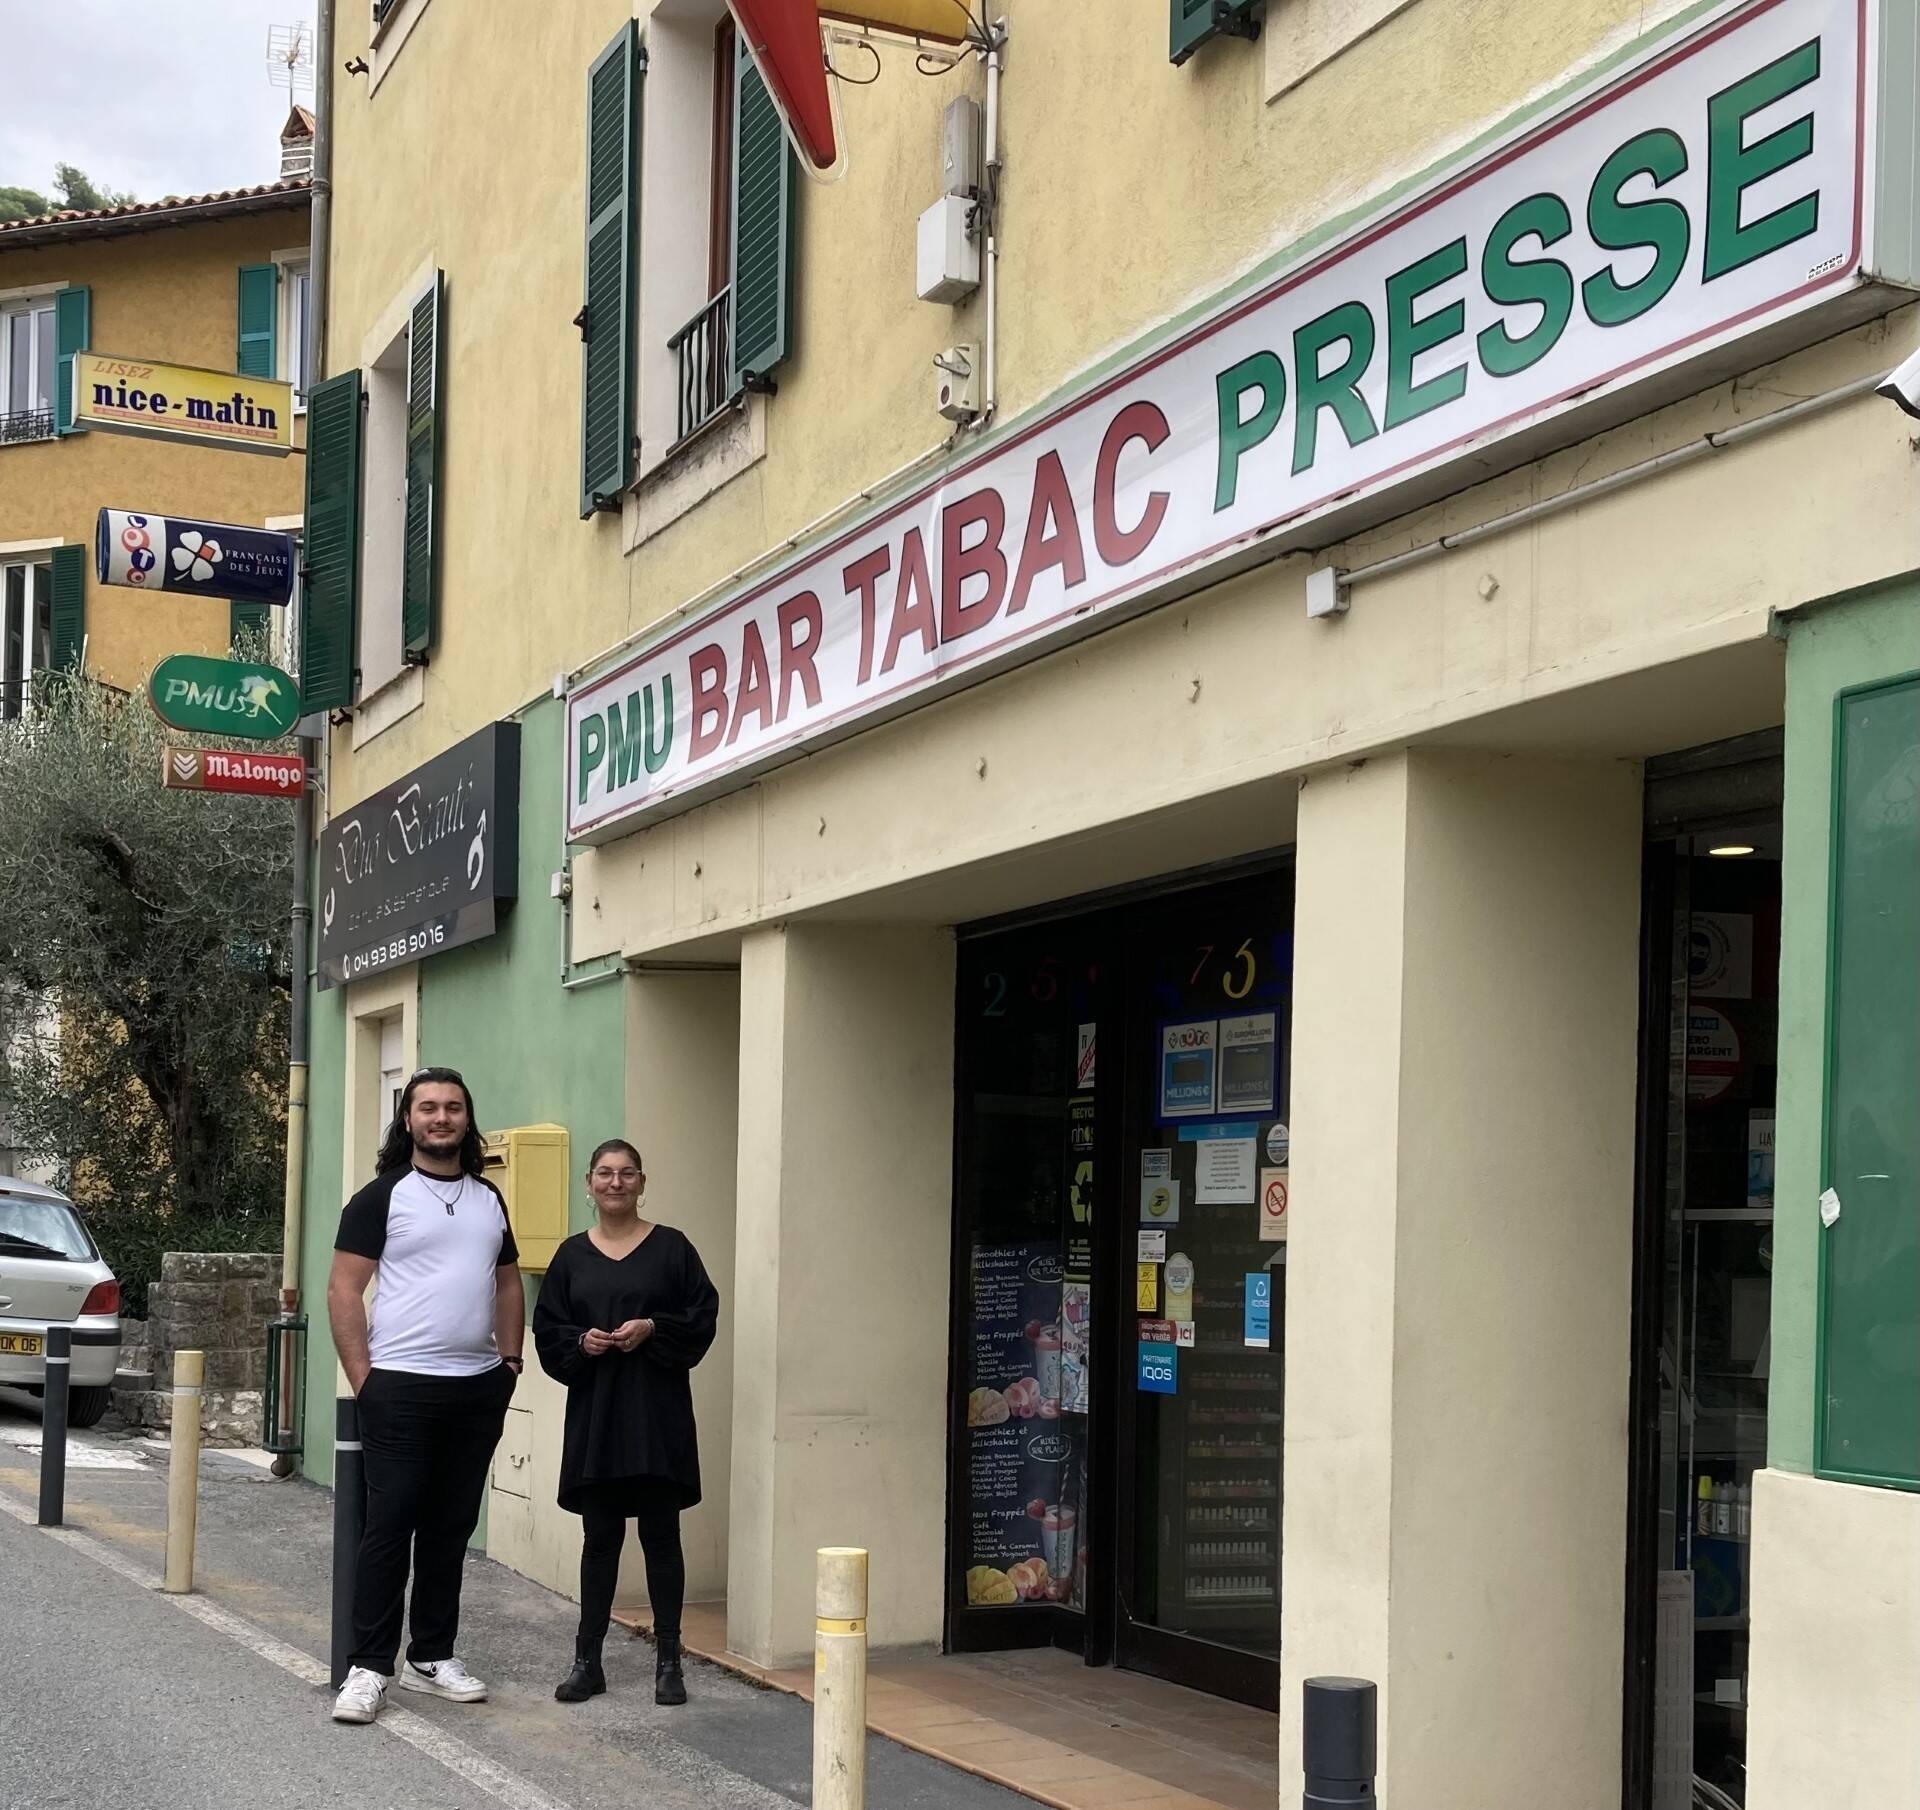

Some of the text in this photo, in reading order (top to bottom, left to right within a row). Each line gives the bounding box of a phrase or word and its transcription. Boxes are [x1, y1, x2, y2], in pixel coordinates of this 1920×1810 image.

[93, 360, 154, 380] LISEZ
[93, 379, 278, 430] nice-matin
[579, 36, 1821, 805] PMU BAR TABAC PRESSE
[226, 549, 288, 565] FRANÇAISE
[230, 562, 283, 577] DES JEUX
[164, 678, 237, 712] PMU
[207, 756, 302, 786] Malongo
[354, 925, 444, 971] 04 93 88 90 16
[1166, 1087, 1202, 1099] MILLIONS
[1141, 1332, 1171, 1343] en vente
[1180, 1327, 1192, 1341] ICI
[21, 1337, 37, 1352] 06
[1142, 1354, 1172, 1365] PARTENAIRE
[1142, 1366, 1172, 1381] IQOS
[972, 1506, 1026, 1520] Nos Frappés
